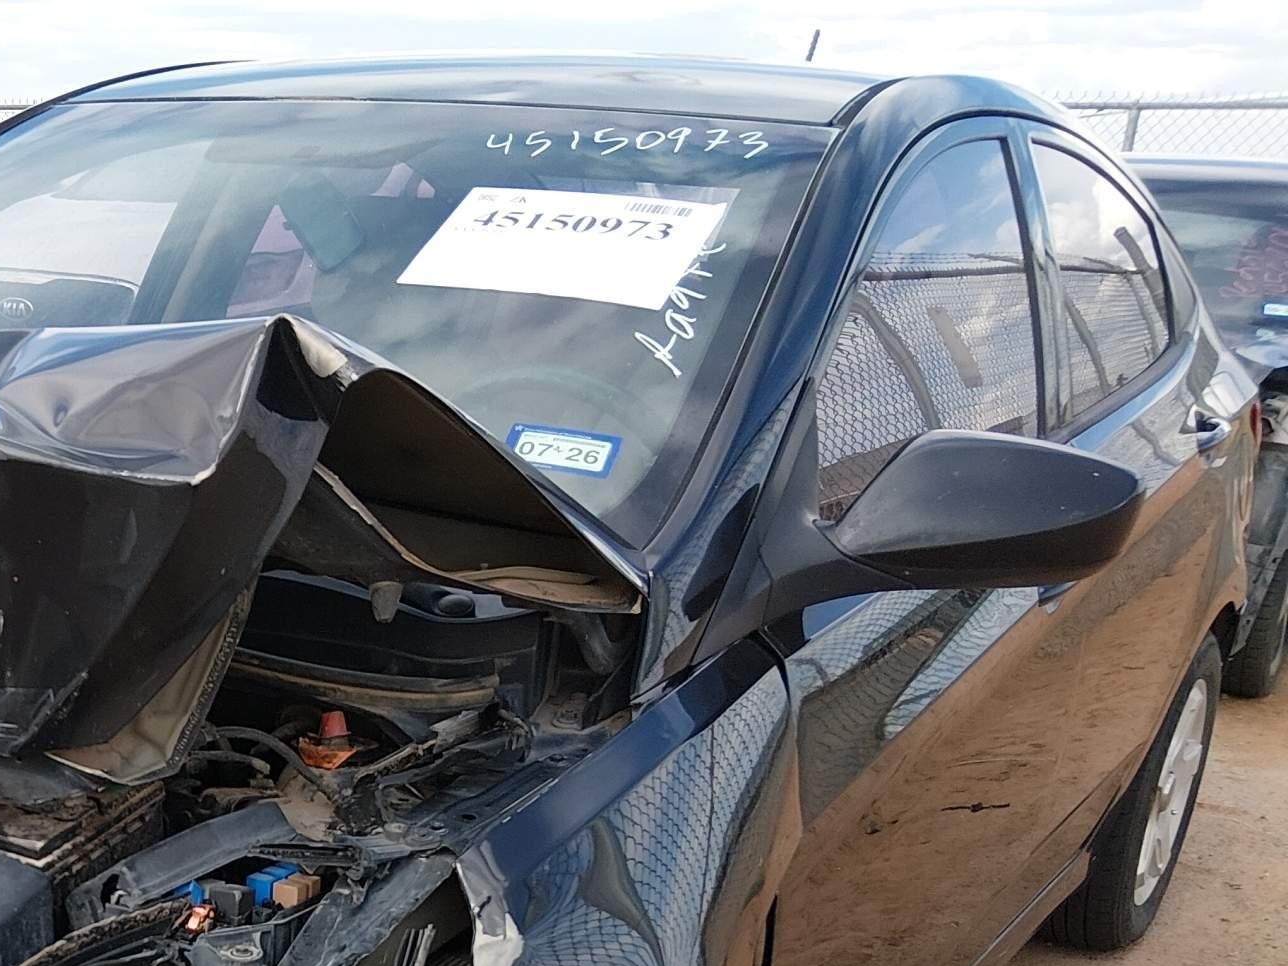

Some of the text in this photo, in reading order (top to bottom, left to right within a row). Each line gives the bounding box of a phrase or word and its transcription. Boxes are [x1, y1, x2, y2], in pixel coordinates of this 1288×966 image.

[486, 126, 769, 159] 45150973
[473, 209, 674, 241] 45150973
[518, 441, 554, 456] 07
[565, 447, 601, 465] 26
